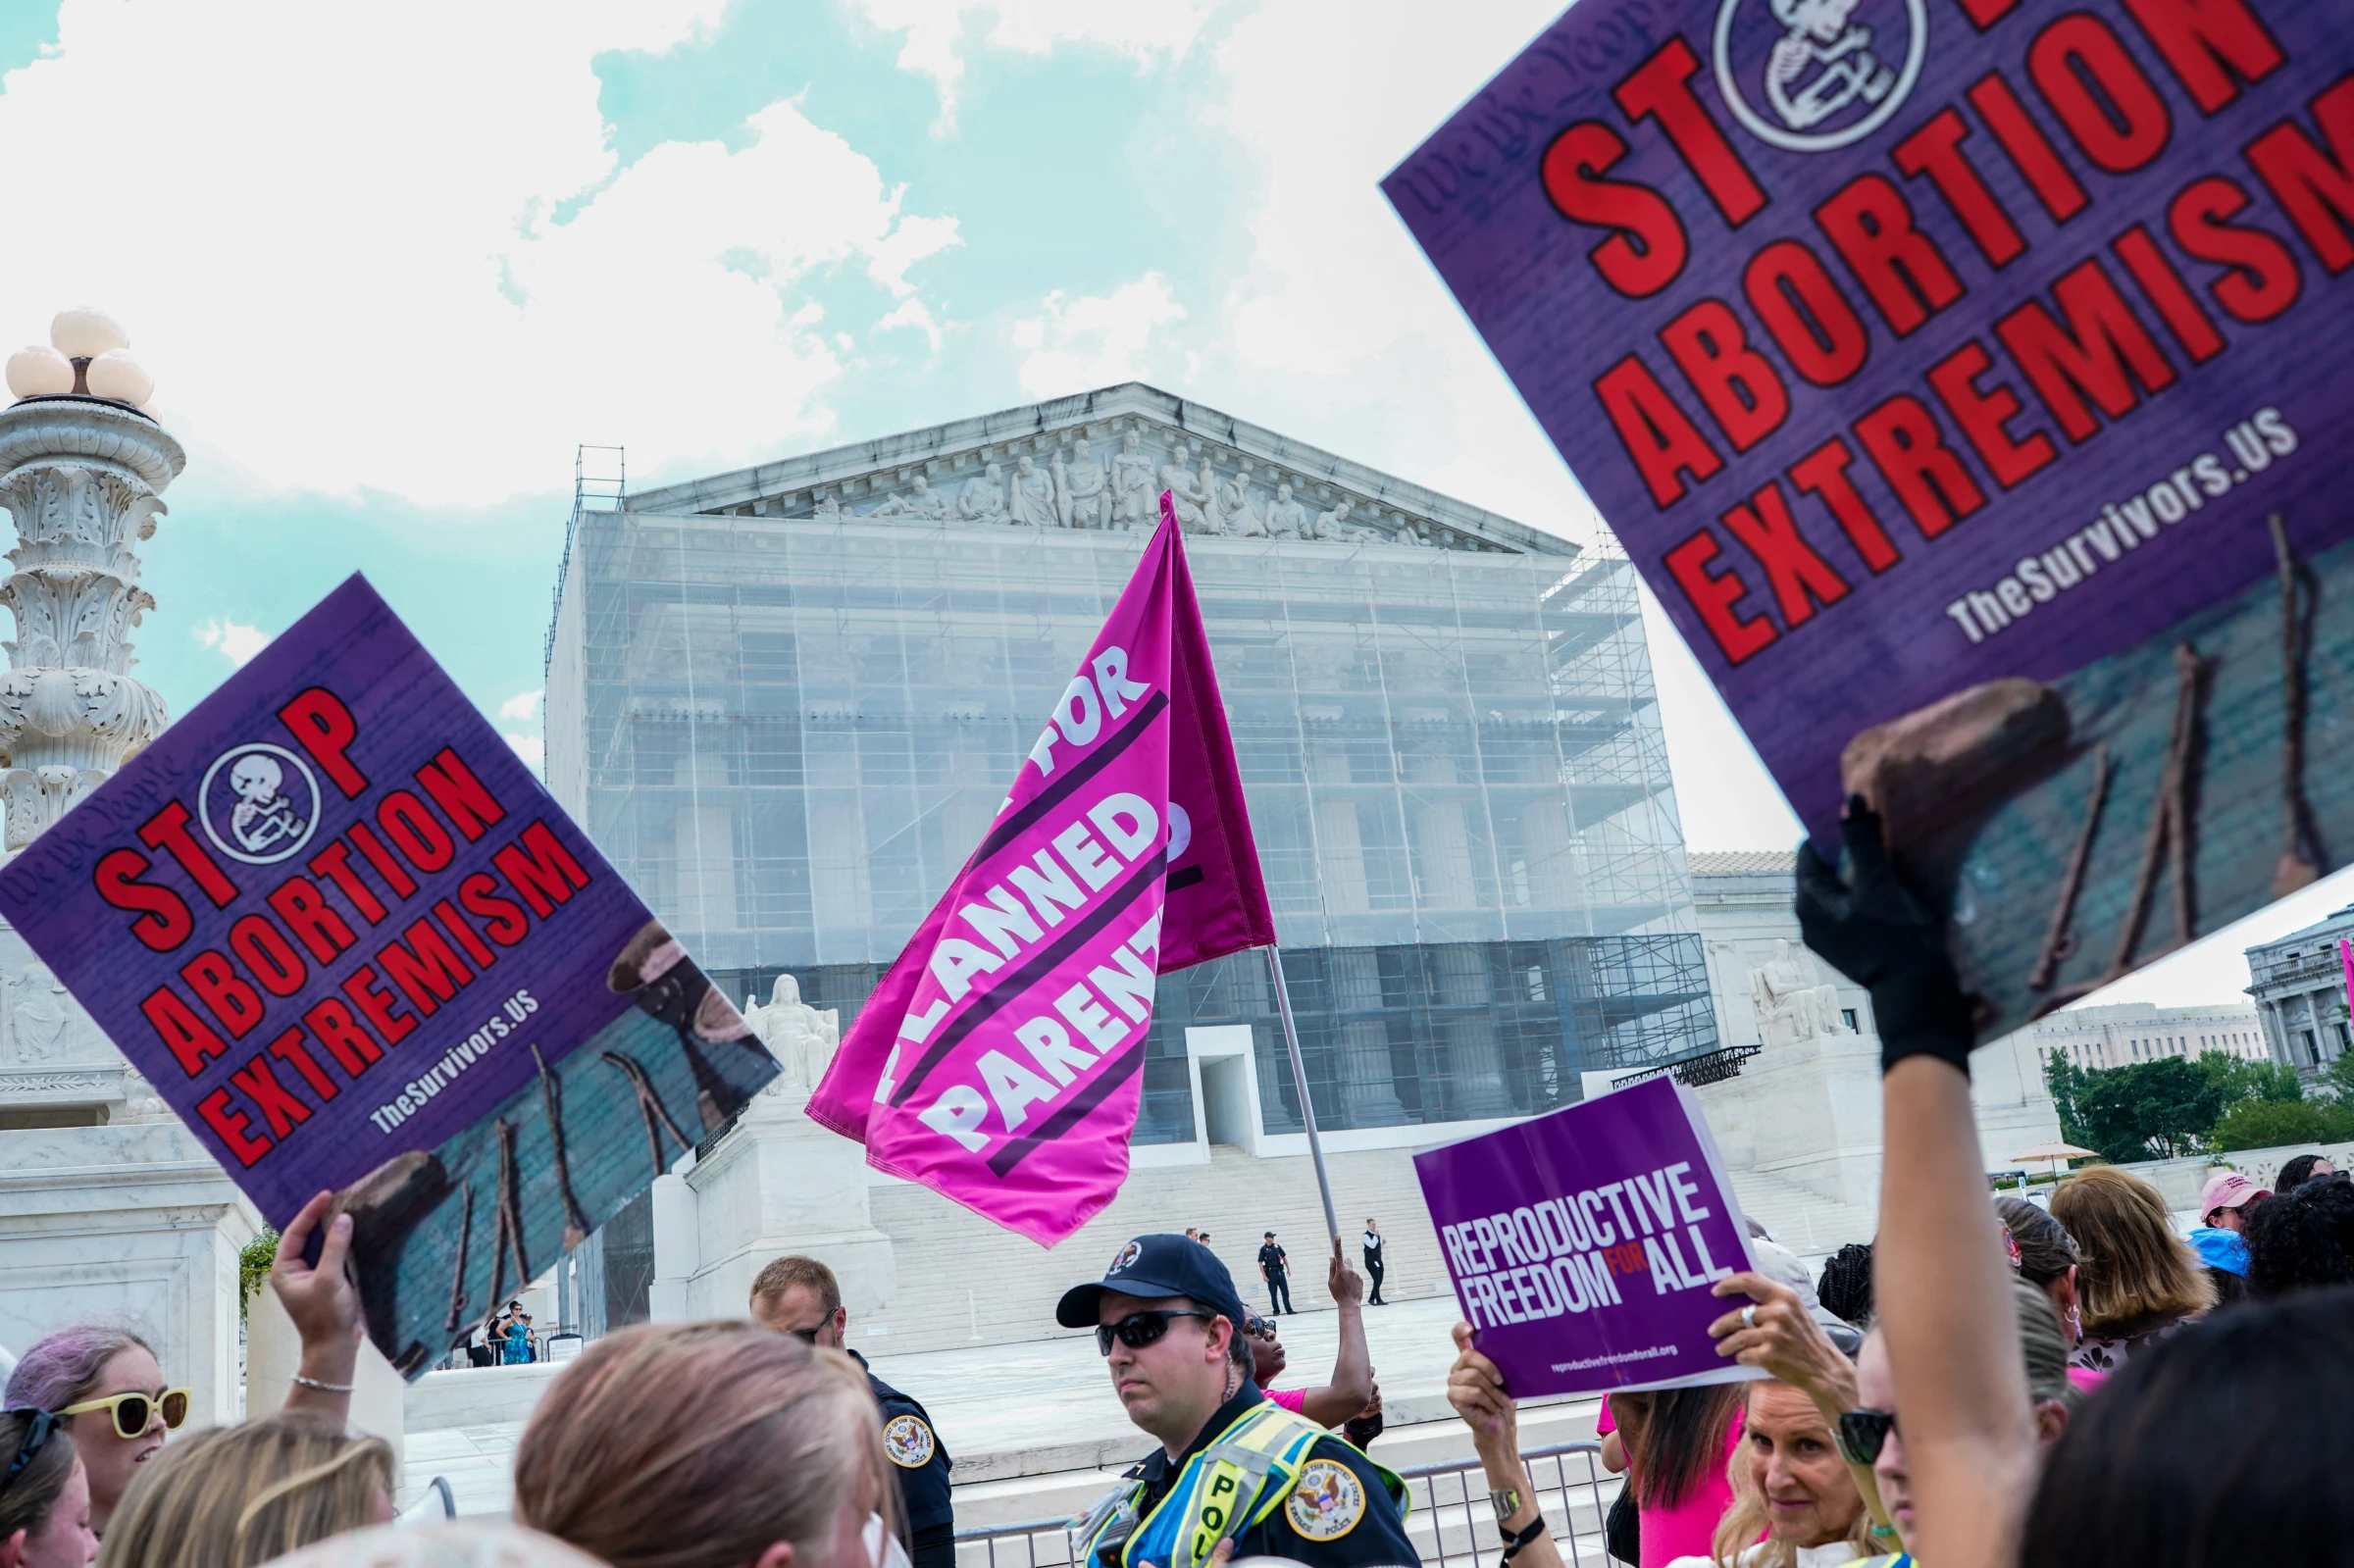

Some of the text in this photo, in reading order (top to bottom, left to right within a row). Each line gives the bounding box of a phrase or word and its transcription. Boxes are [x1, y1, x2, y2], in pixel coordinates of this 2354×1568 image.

[1540, 0, 2019, 300] STO
[1590, 0, 2289, 511] ABORTION
[1662, 73, 2354, 668] EXTREMISM
[1944, 406, 2299, 644] TheSurvivors.US
[139, 745, 508, 1079] ABORTION
[195, 818, 592, 1169] EXTREMISM
[917, 902, 1164, 1154] PARENT
[369, 988, 539, 1135] TheSurvivors.US
[1442, 1160, 1711, 1278] REPRODUCTIVE
[1458, 1225, 1734, 1330] FREEDOM FOR ALL
[1325, 1516, 1353, 1536] POLICE
